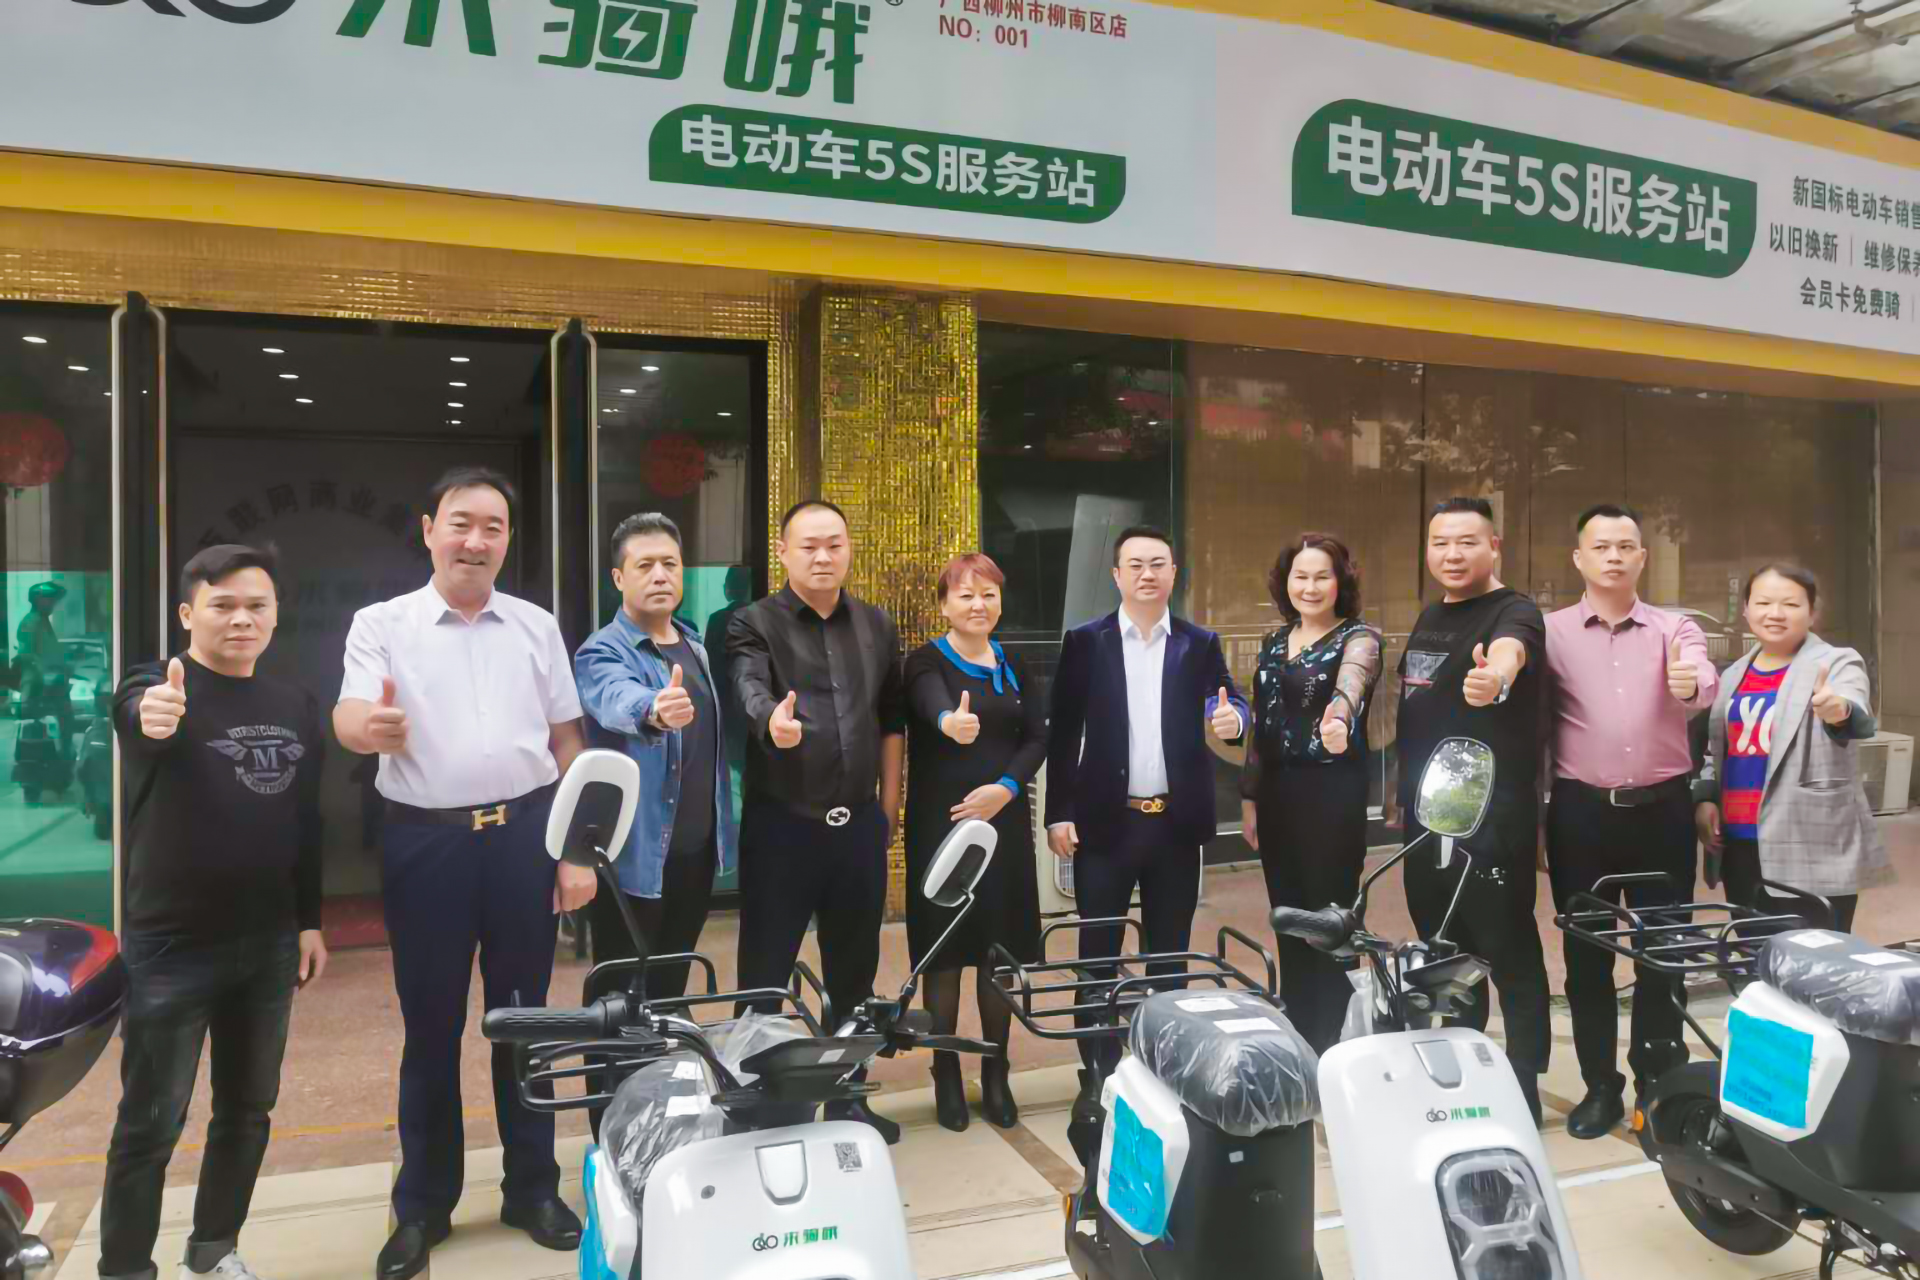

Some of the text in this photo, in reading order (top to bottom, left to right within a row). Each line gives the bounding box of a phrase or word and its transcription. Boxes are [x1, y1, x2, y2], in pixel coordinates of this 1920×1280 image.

[681, 114, 1097, 208] 电动车5S服务站
[1327, 115, 1731, 254] 电动车5S服务站
[1769, 222, 1838, 264] 以旧换新
[1800, 276, 1900, 320] 会员卡免费骑
